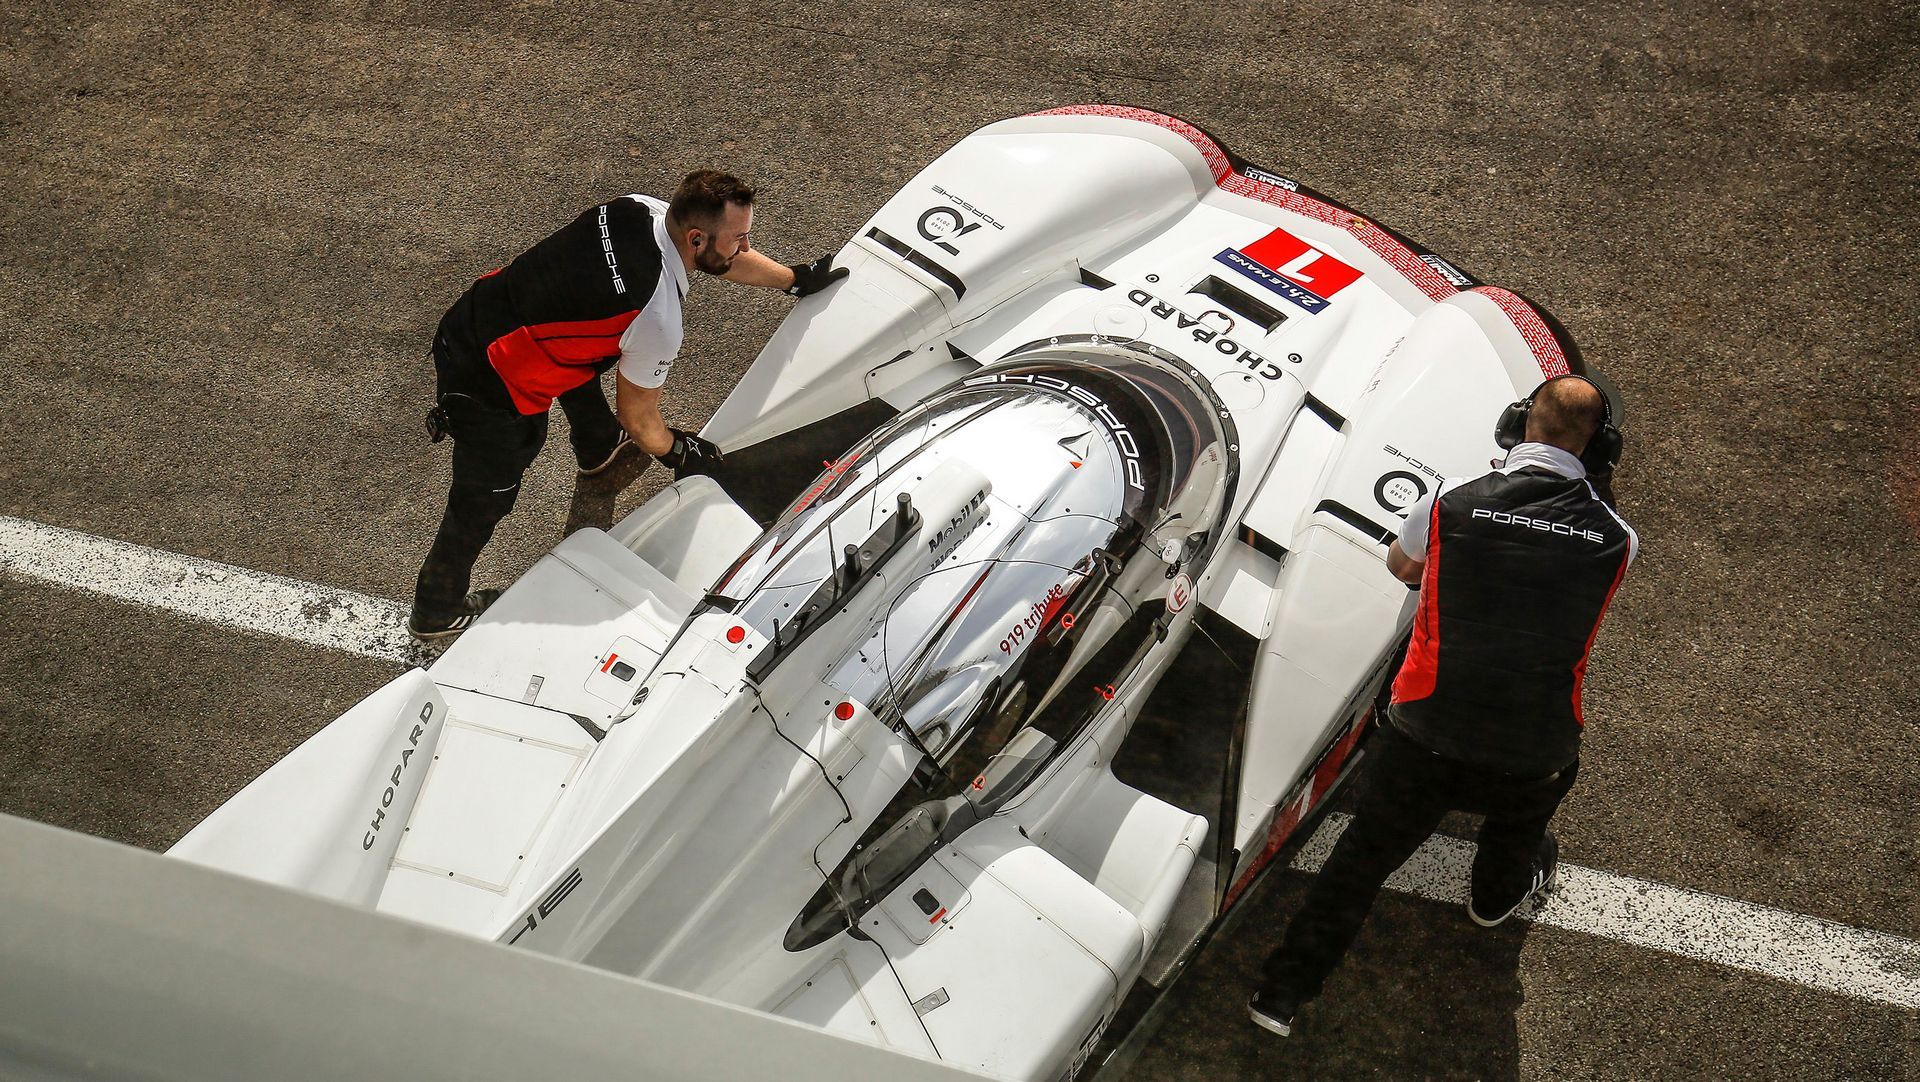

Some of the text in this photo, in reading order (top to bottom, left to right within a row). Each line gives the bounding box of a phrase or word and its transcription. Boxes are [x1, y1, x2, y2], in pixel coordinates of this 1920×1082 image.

[931, 184, 1005, 231] PORSCHE
[598, 204, 627, 295] PORSCHE
[1227, 253, 1270, 278] MANS
[1276, 248, 1325, 283] 1
[1271, 277, 1290, 289] LE
[1128, 289, 1283, 380] CHOPARD
[962, 374, 1145, 491] PORSCHE
[928, 504, 970, 554] Mobil
[1471, 508, 1604, 545] PORSCHE
[999, 582, 1064, 657] 919 tribute
[362, 700, 434, 851] CHOPARD
